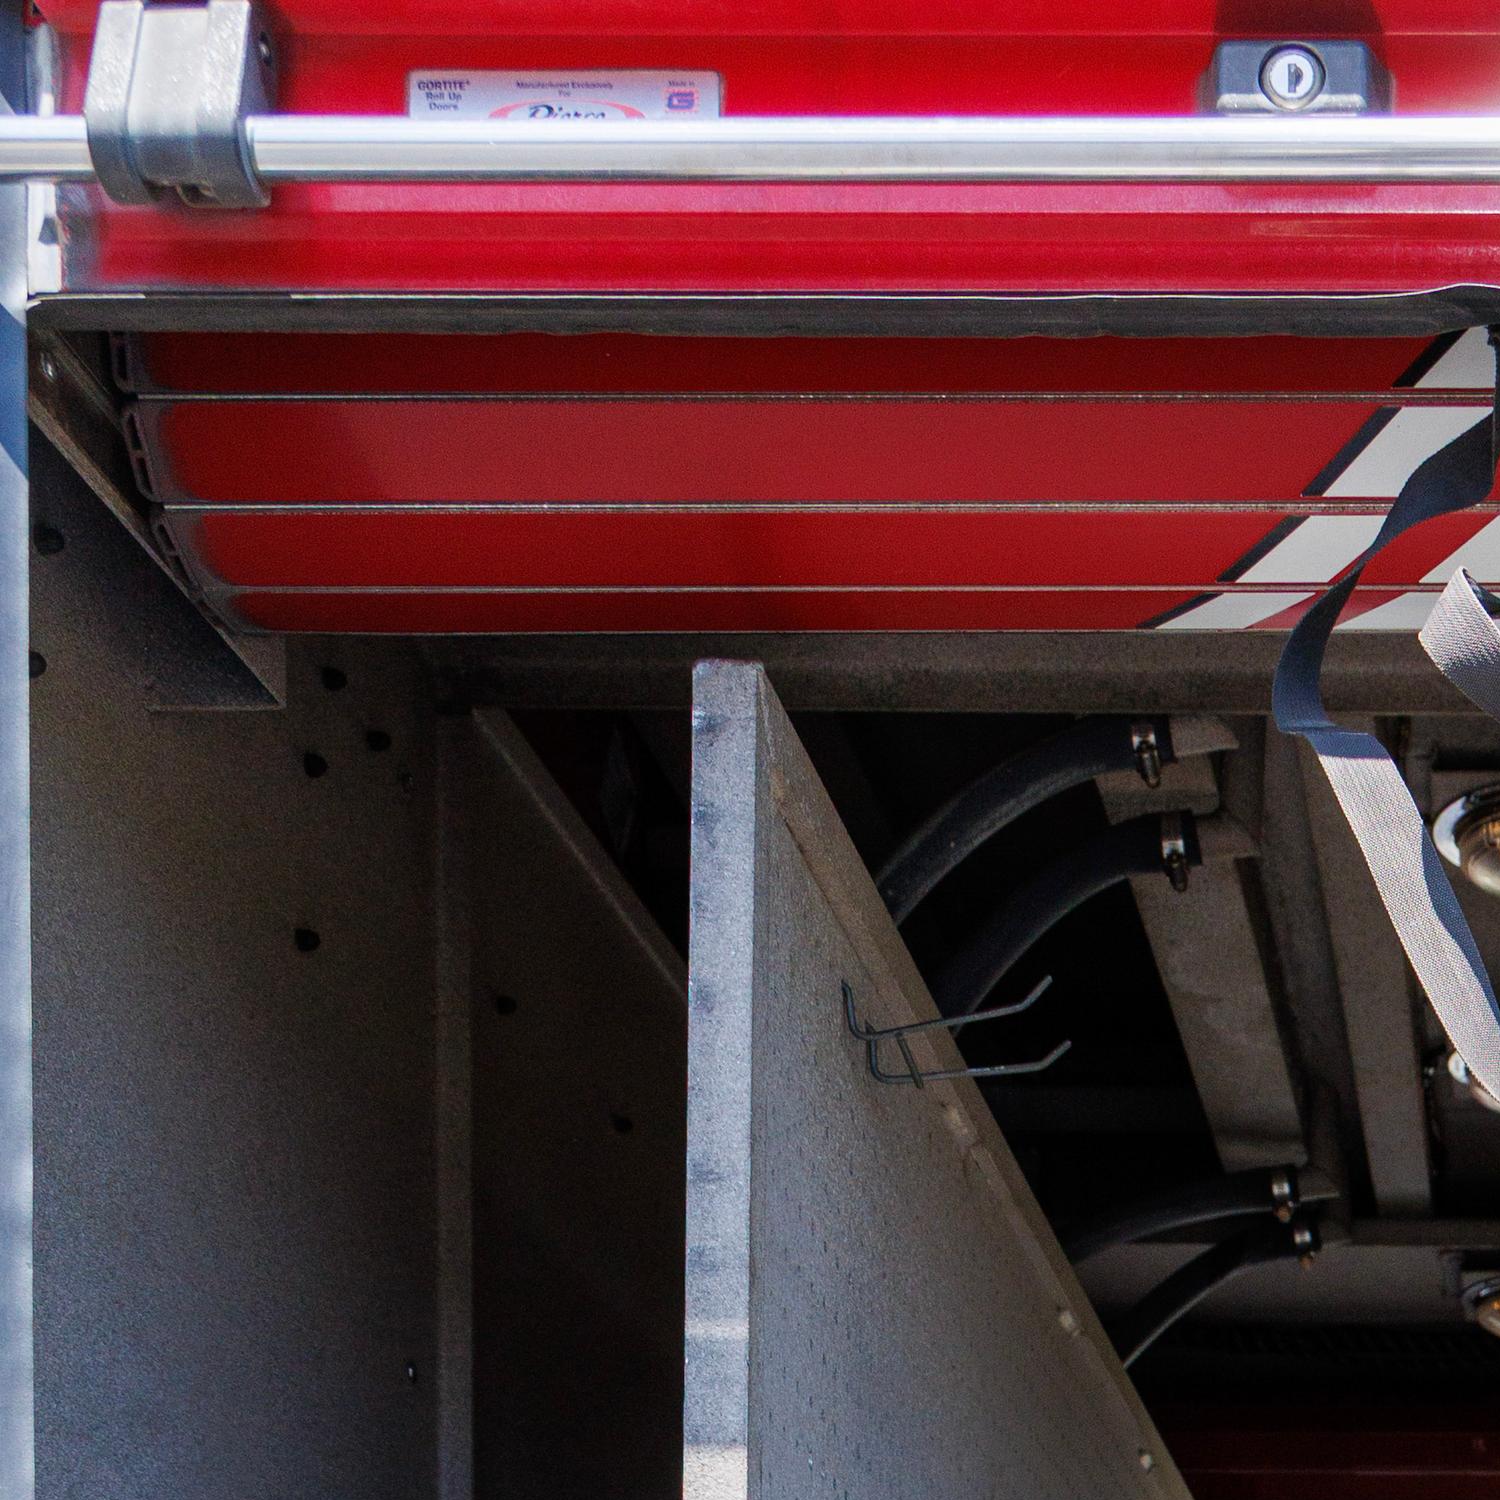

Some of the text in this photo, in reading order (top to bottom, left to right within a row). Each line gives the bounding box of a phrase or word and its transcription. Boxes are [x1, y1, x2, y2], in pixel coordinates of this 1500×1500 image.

[571, 81, 613, 90] Exclusively
[425, 91, 462, 101] Roll Up
[428, 102, 459, 111] Doors
